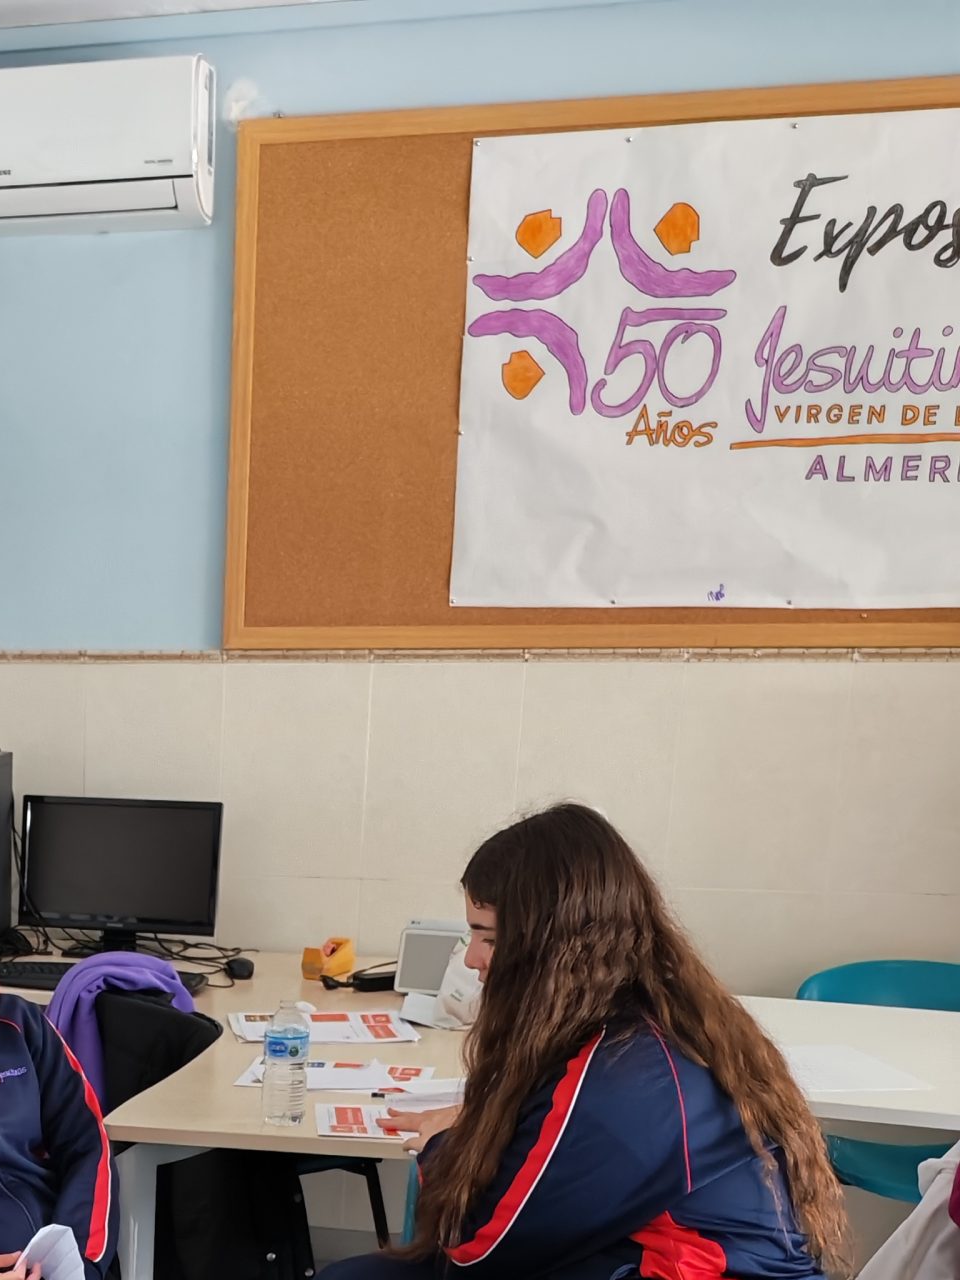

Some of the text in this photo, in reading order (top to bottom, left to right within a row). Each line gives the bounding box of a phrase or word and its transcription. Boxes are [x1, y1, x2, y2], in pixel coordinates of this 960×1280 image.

[591, 306, 727, 418] 50
[626, 403, 718, 447] Años
[774, 404, 886, 425] VIRGEN
[901, 404, 940, 426] DE
